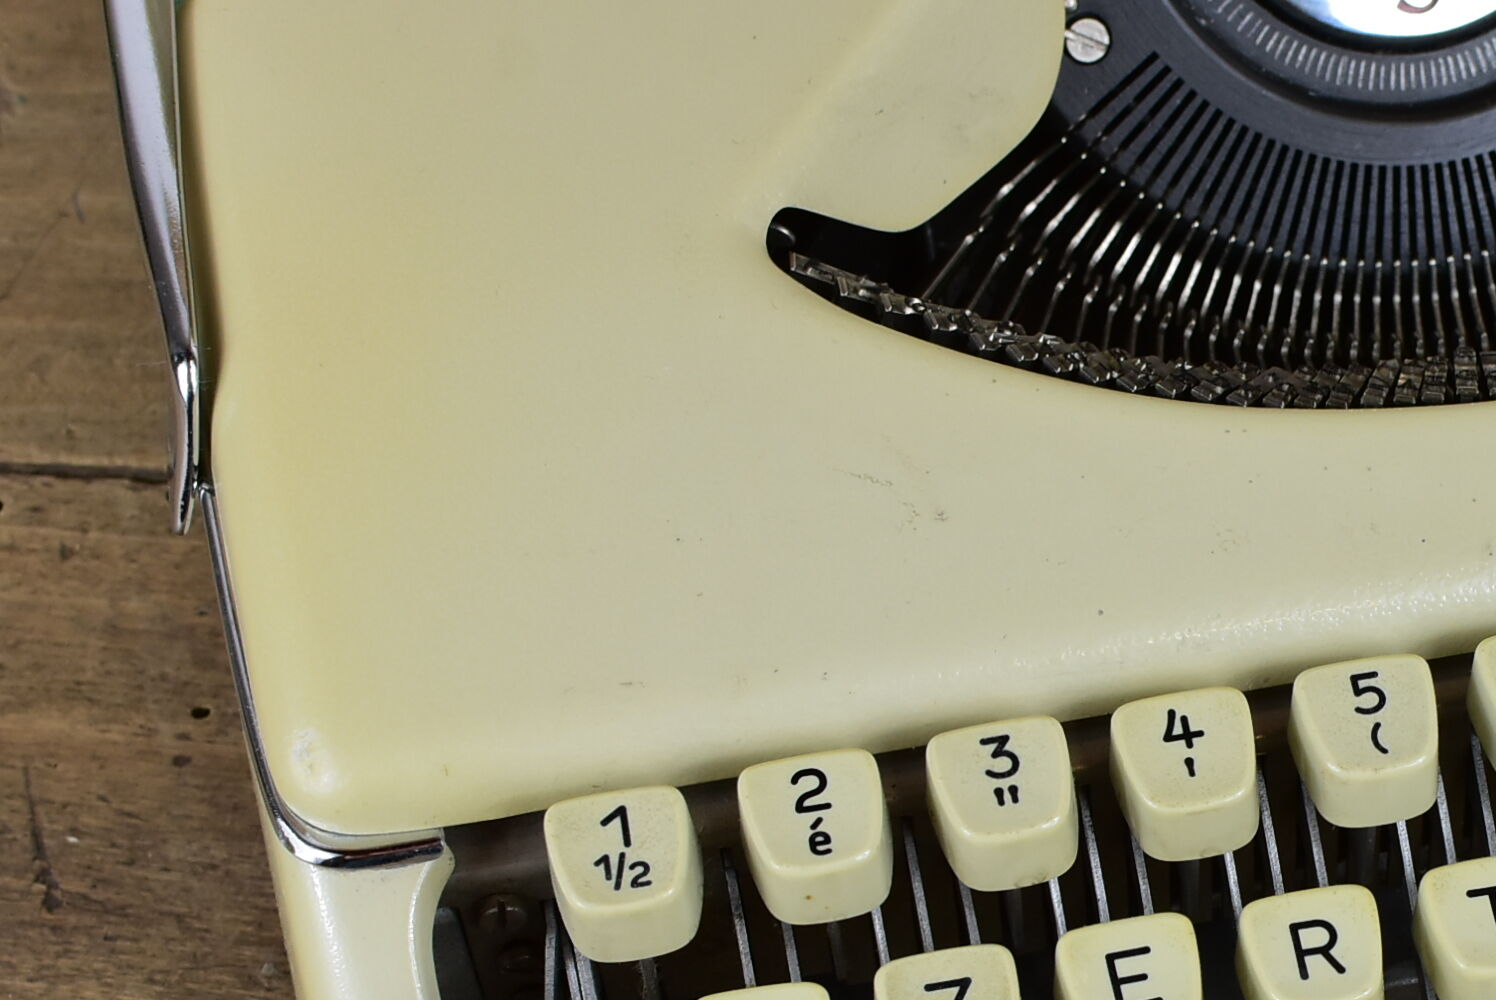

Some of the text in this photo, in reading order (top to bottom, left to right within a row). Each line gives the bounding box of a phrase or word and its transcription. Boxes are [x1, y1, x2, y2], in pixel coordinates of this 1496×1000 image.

[1349, 670, 1387, 715] 5
[1162, 708, 1205, 750] 4
[1370, 721, 1389, 755] (
[979, 734, 1020, 780] 3
[790, 767, 833, 814] 2
[599, 805, 632, 848] 1
[808, 816, 833, 856] é
[1288, 919, 1347, 981] R
